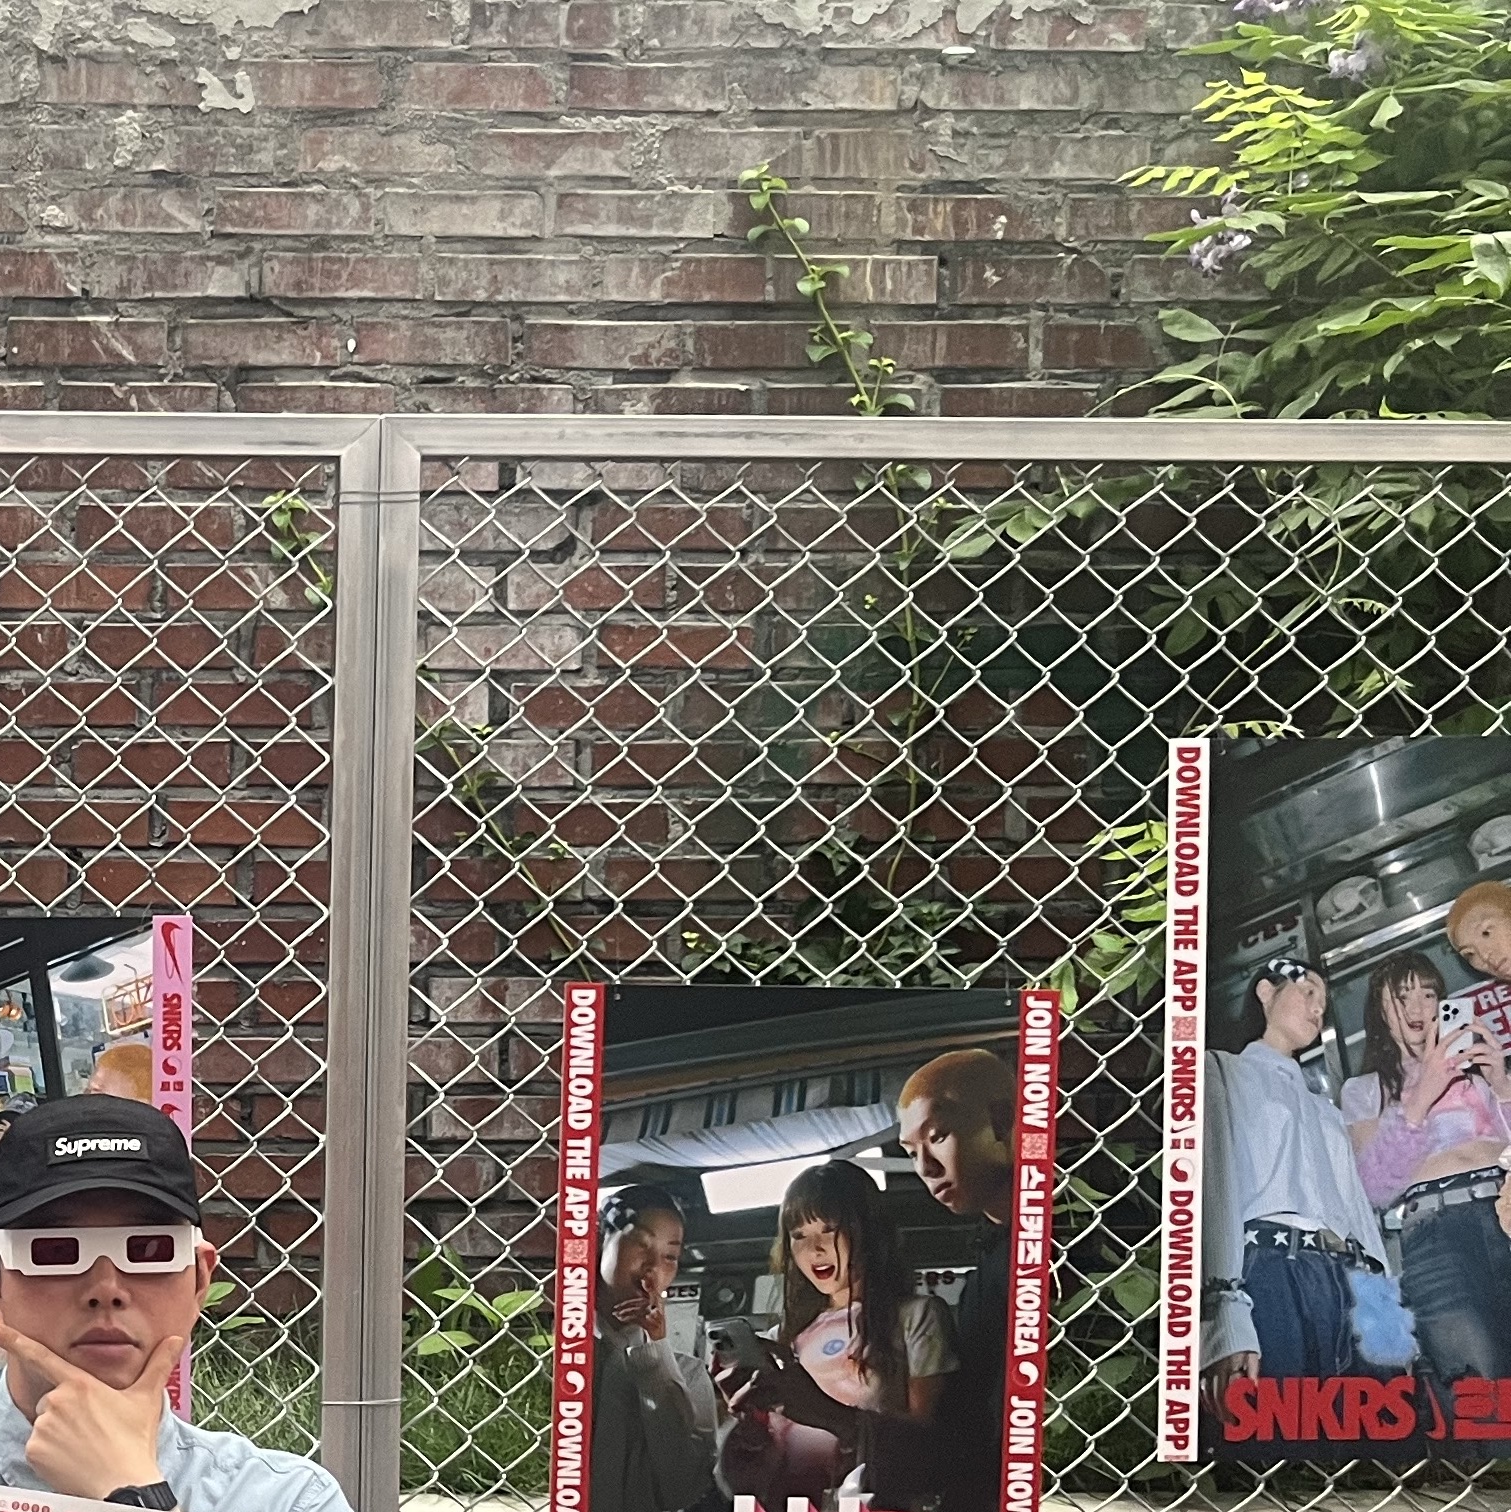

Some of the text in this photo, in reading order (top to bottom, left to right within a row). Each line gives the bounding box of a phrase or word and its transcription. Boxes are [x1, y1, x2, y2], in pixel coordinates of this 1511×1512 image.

[1174, 746, 1201, 897] DOWNLOAD
[1173, 905, 1199, 950] THE
[1171, 959, 1198, 1012] APP
[161, 992, 182, 1052] SNKRS
[1025, 995, 1053, 1056] JOIN
[567, 988, 597, 1130] DOWNLOAD
[1170, 1046, 1196, 1125] SNKRS
[1021, 1063, 1051, 1129] NOW
[54, 1137, 142, 1158] Supreme
[565, 1135, 592, 1180] THE
[563, 1186, 590, 1237] APP
[1017, 1164, 1046, 1265] 스니커즈
[1166, 1190, 1194, 1338] DOWNLOAD
[562, 1266, 588, 1340] SNKRS
[1014, 1278, 1042, 1357] KOREA
[1165, 1346, 1191, 1391] THE
[1007, 1395, 1037, 1455] JOIN
[1164, 1399, 1190, 1451] APP
[1224, 1376, 1416, 1441] SNKRS
